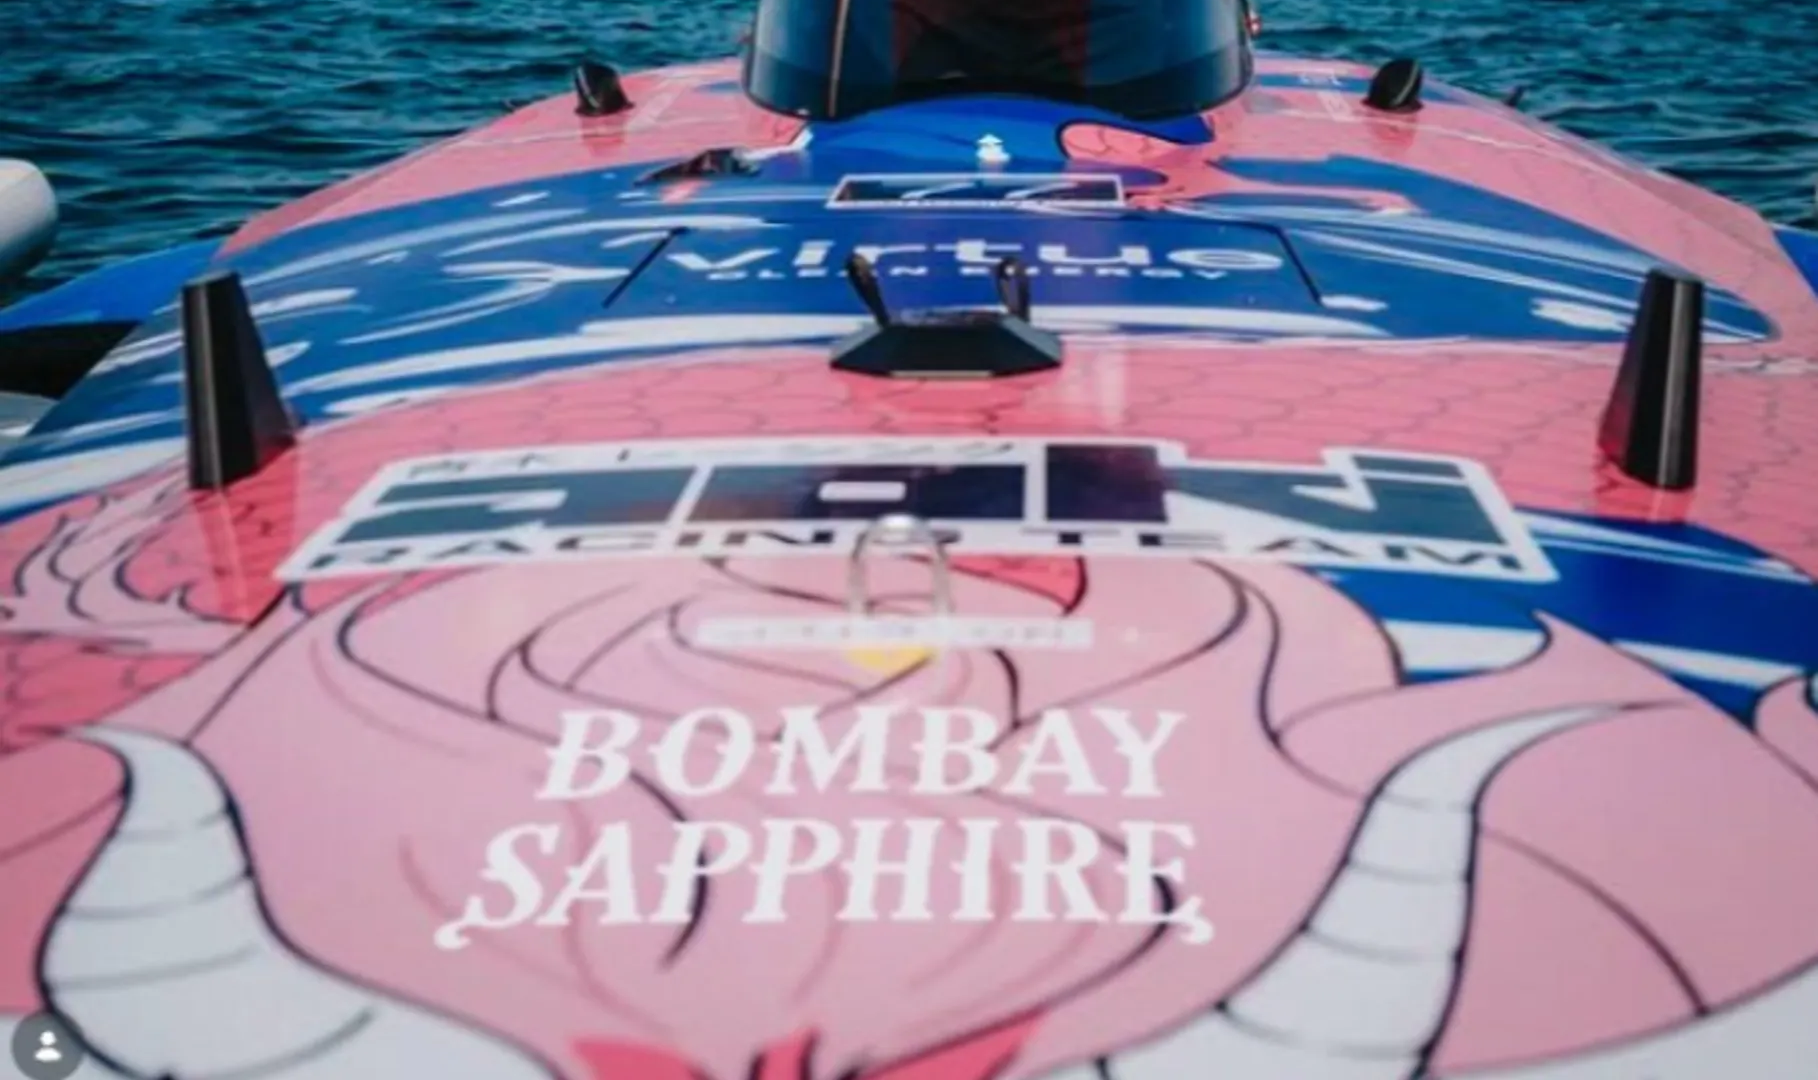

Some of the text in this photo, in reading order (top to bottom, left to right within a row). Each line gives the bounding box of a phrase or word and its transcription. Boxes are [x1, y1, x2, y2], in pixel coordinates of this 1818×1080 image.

[706, 265, 928, 281] CLEN
[1020, 526, 1525, 571] TEAM
[534, 705, 1187, 801] BOMBAY
[434, 818, 1215, 951] SAPPHIRE
